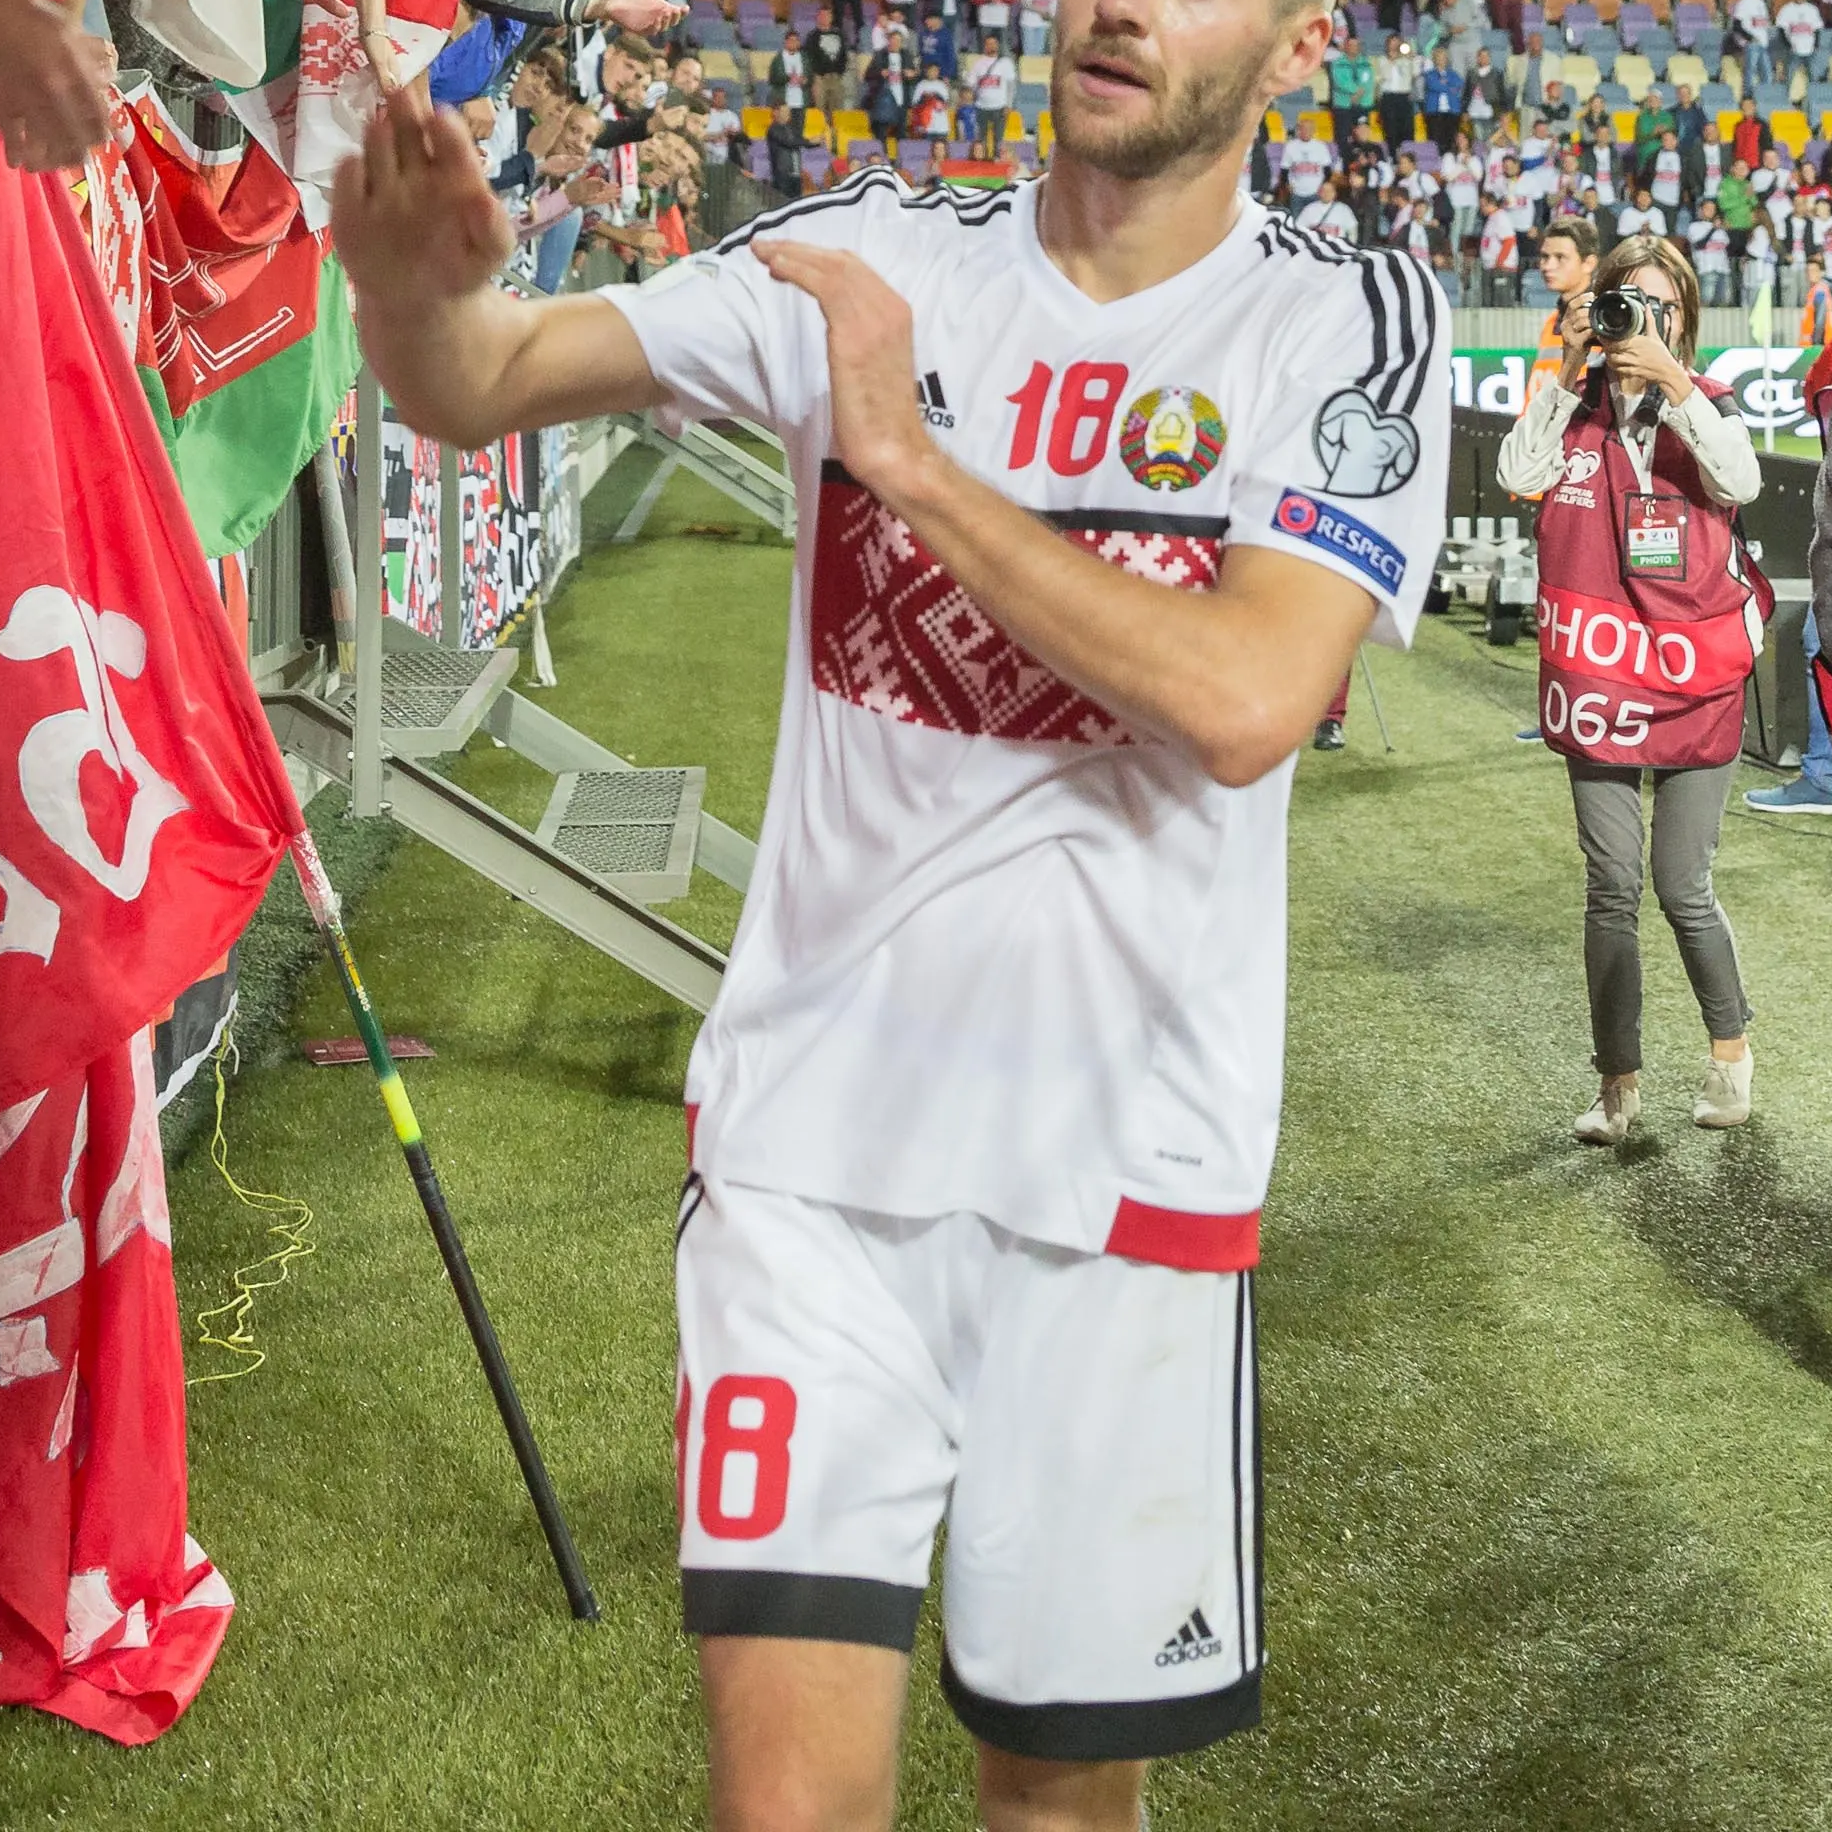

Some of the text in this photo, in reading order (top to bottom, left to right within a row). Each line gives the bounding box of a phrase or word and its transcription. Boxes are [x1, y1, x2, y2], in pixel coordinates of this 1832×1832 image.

[1005, 359, 1129, 477] 18
[1316, 515, 1405, 584] RESPECT
[1639, 555, 1673, 566] PHOTO
[1545, 679, 1655, 747] 065
[1154, 1639, 1222, 1667] adidas
